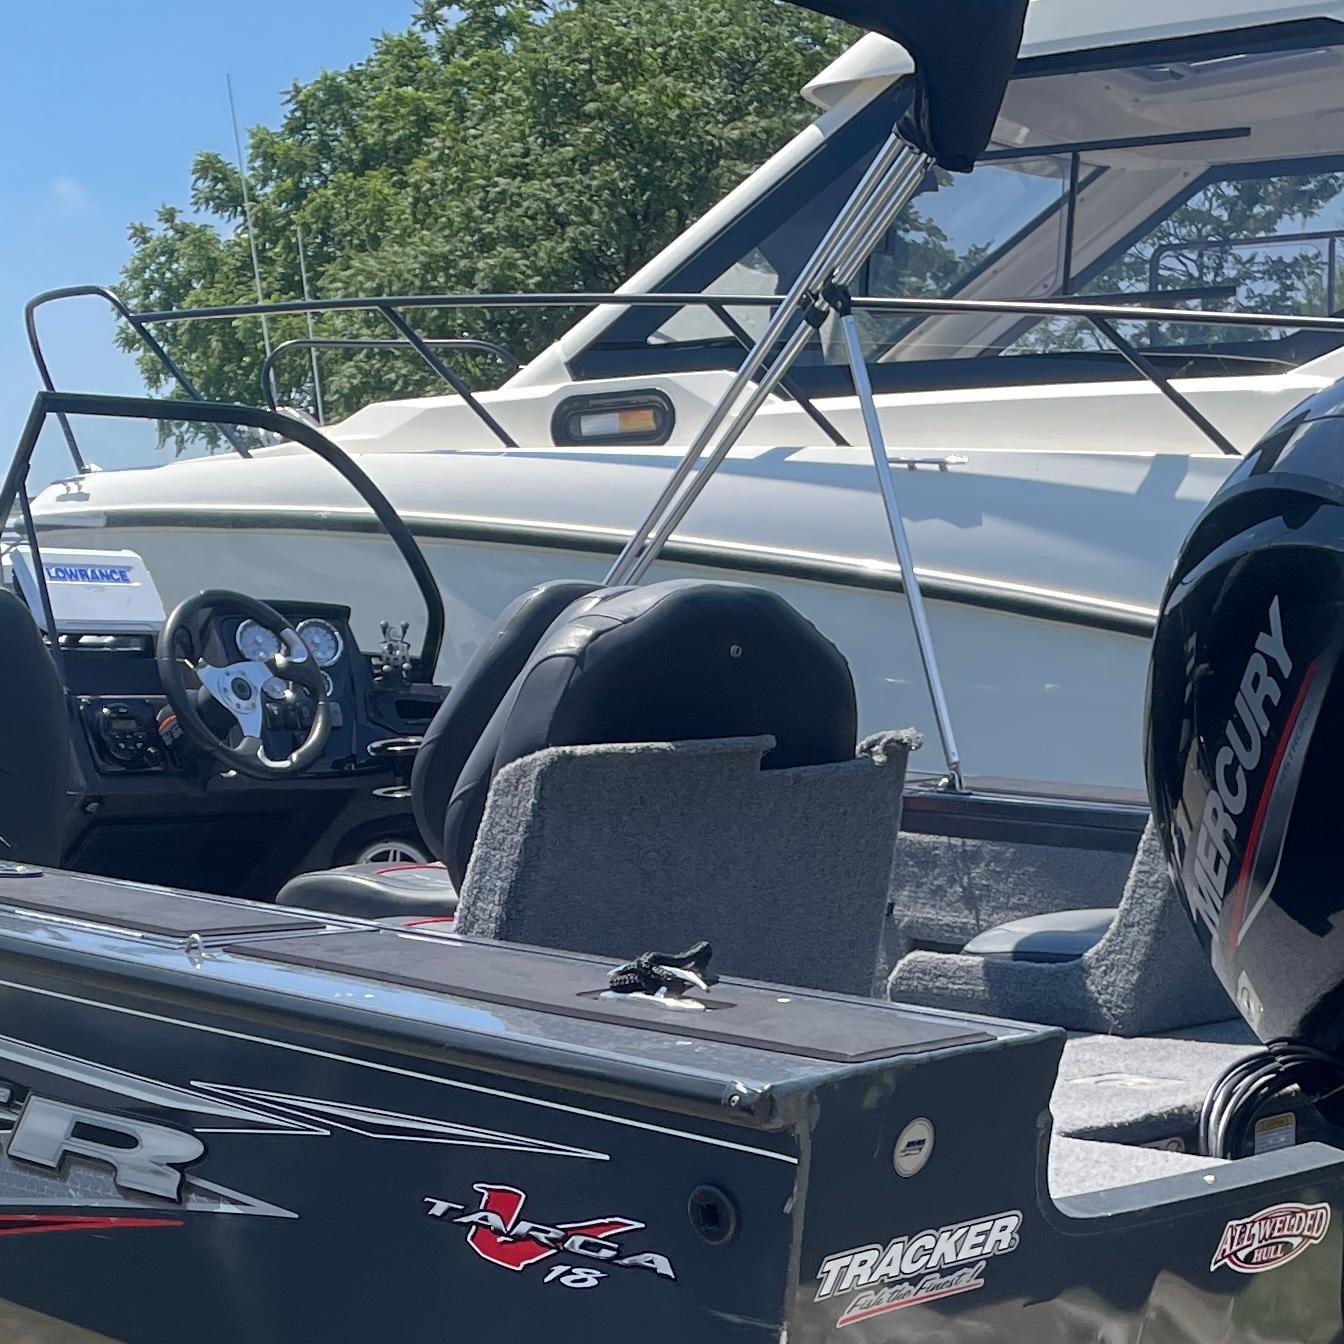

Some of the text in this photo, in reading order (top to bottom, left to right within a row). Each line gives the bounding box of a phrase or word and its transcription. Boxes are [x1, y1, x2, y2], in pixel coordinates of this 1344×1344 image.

[45, 565, 130, 583] LOWRANCE
[1191, 595, 1293, 942] MERCURY
[423, 1196, 676, 1281] TARGA
[819, 1214, 1022, 1297] TRACKER
[1214, 1208, 1328, 1262] ALL WELDED
[1252, 1244, 1285, 1263] HULL
[543, 1264, 608, 1288] 18
